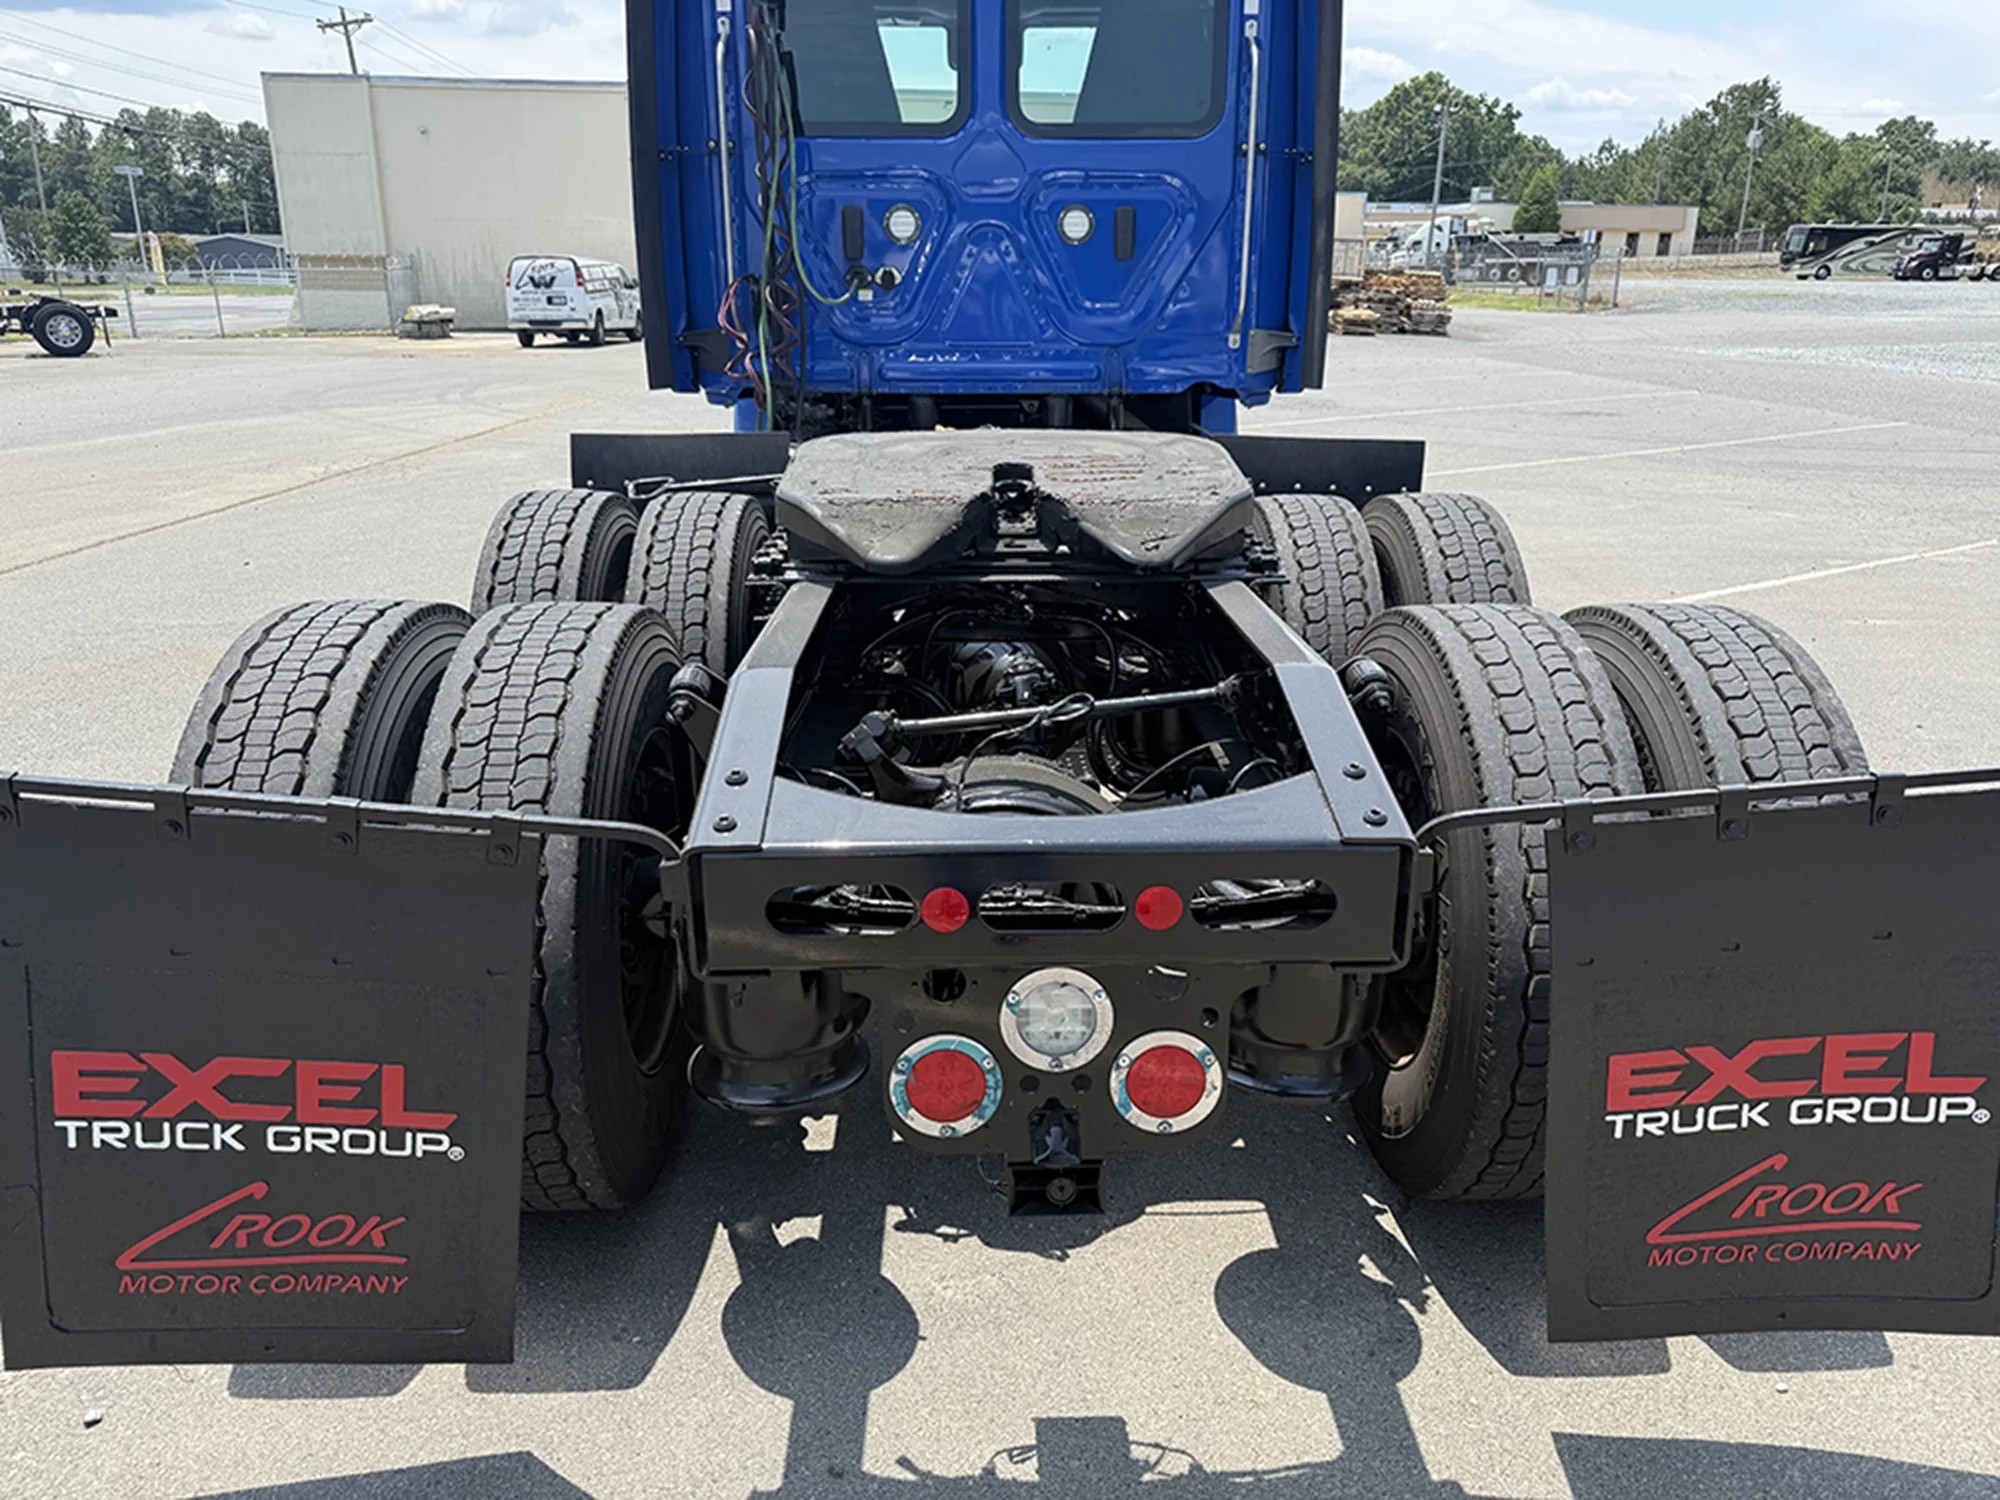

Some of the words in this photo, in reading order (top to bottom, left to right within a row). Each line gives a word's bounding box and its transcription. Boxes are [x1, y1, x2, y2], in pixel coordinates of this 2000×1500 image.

[50, 1050, 459, 1129] EXCEL
[1605, 1032, 1988, 1112] EXCEL
[53, 1120, 246, 1152] TRUCK
[1604, 1101, 1770, 1140] TRUCK
[1647, 1244, 1759, 1268] MOTOR
[1764, 1241, 1922, 1263] COMPANY
[118, 1274, 241, 1295] MOTOR
[249, 1274, 410, 1295] COMPANY
